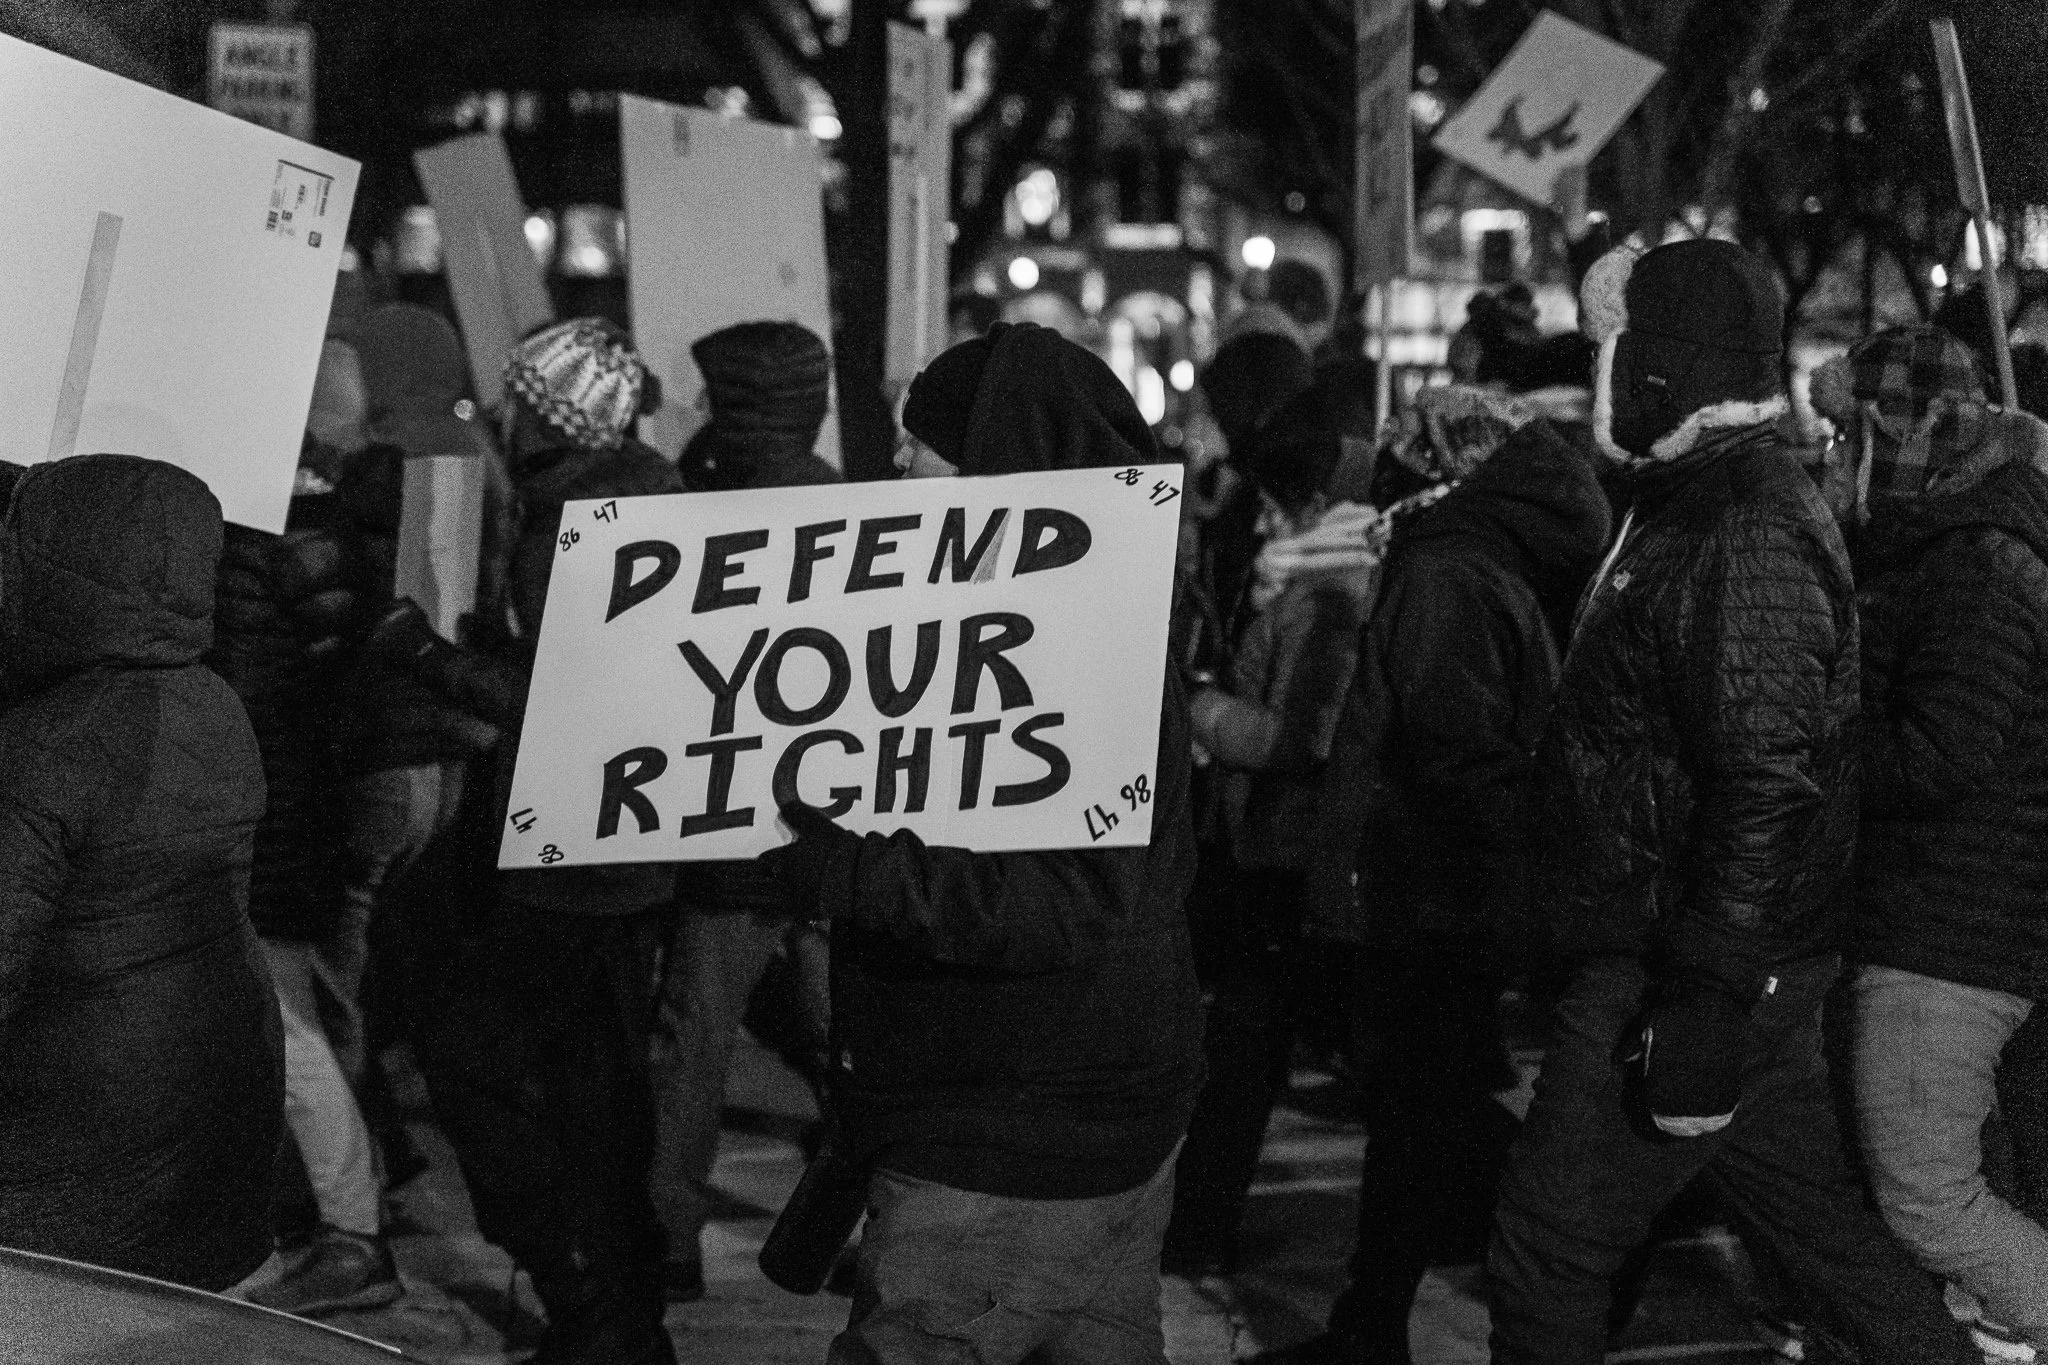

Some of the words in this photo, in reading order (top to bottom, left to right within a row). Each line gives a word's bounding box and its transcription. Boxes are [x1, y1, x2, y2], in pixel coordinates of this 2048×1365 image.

[1149, 479, 1181, 507] 47
[559, 527, 580, 552] 86
[593, 499, 618, 523] 47
[604, 507, 1092, 624] DEFEND
[677, 611, 1035, 738] YOUR
[595, 711, 1072, 840] RIGHTS
[1120, 773, 1152, 812] 86
[509, 807, 538, 835] 47
[1083, 804, 1120, 842] 47
